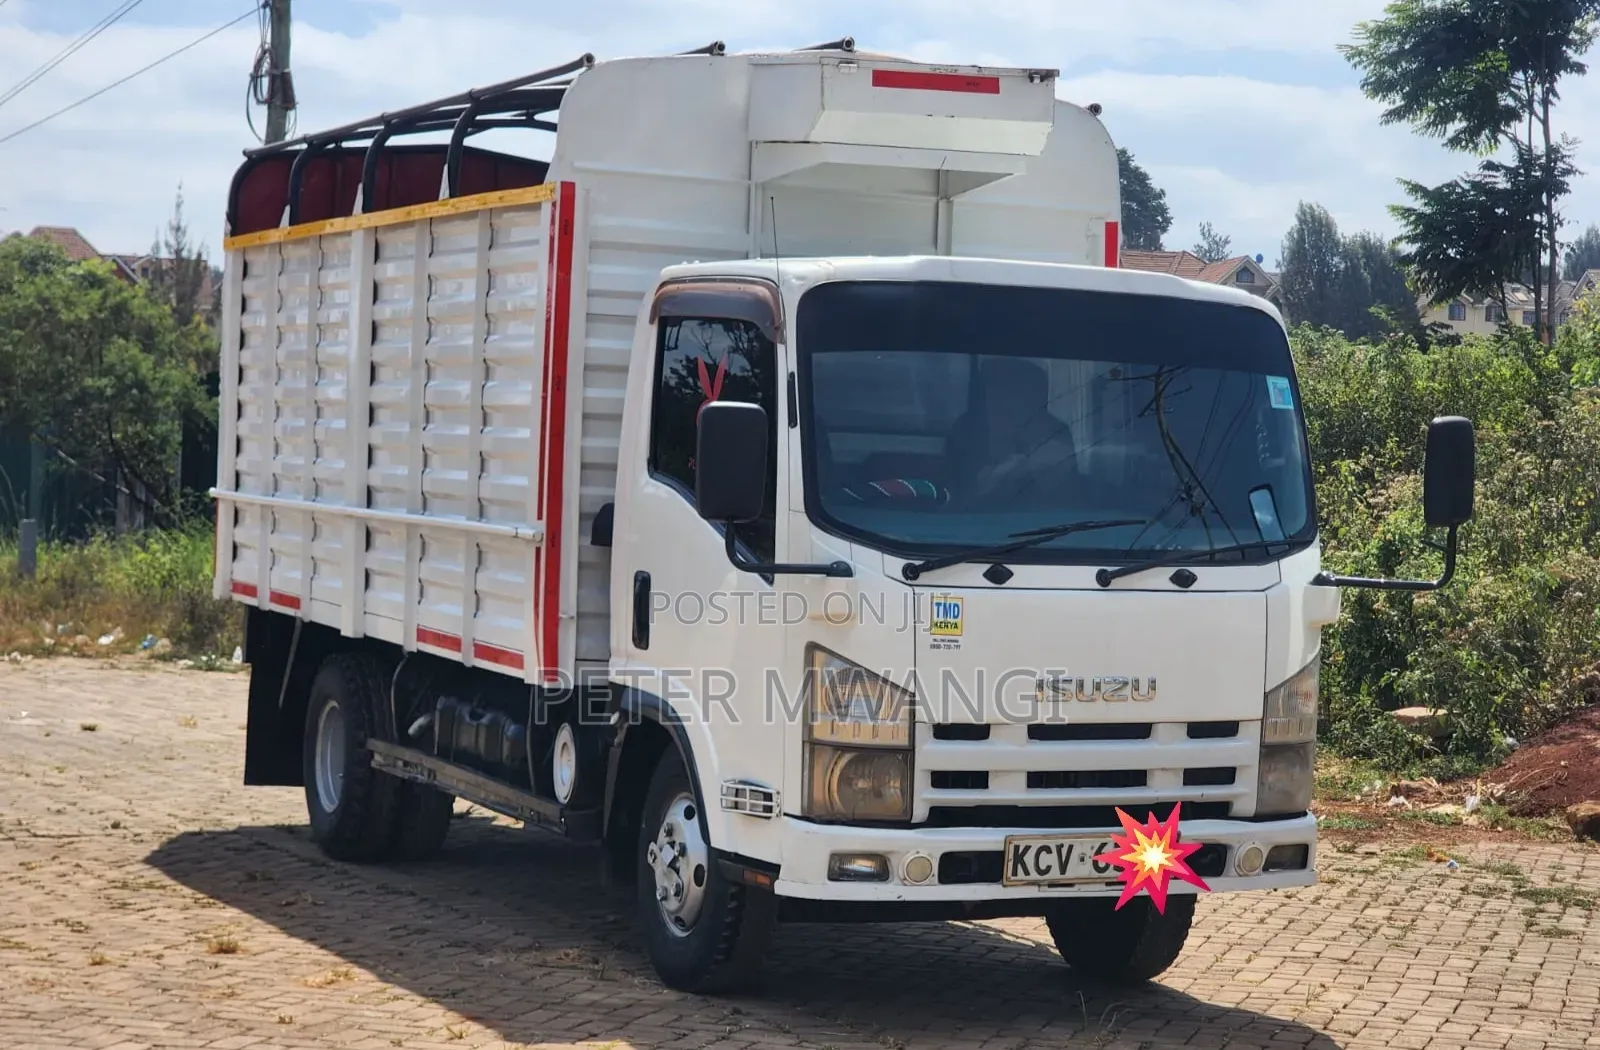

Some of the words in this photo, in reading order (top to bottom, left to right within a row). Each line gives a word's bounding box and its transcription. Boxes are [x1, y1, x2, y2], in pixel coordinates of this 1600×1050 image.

[935, 602, 960, 619] TMD
[934, 621, 959, 630] KENYA
[1035, 676, 1157, 702] ISUZU
[1011, 843, 1074, 877] KCV
